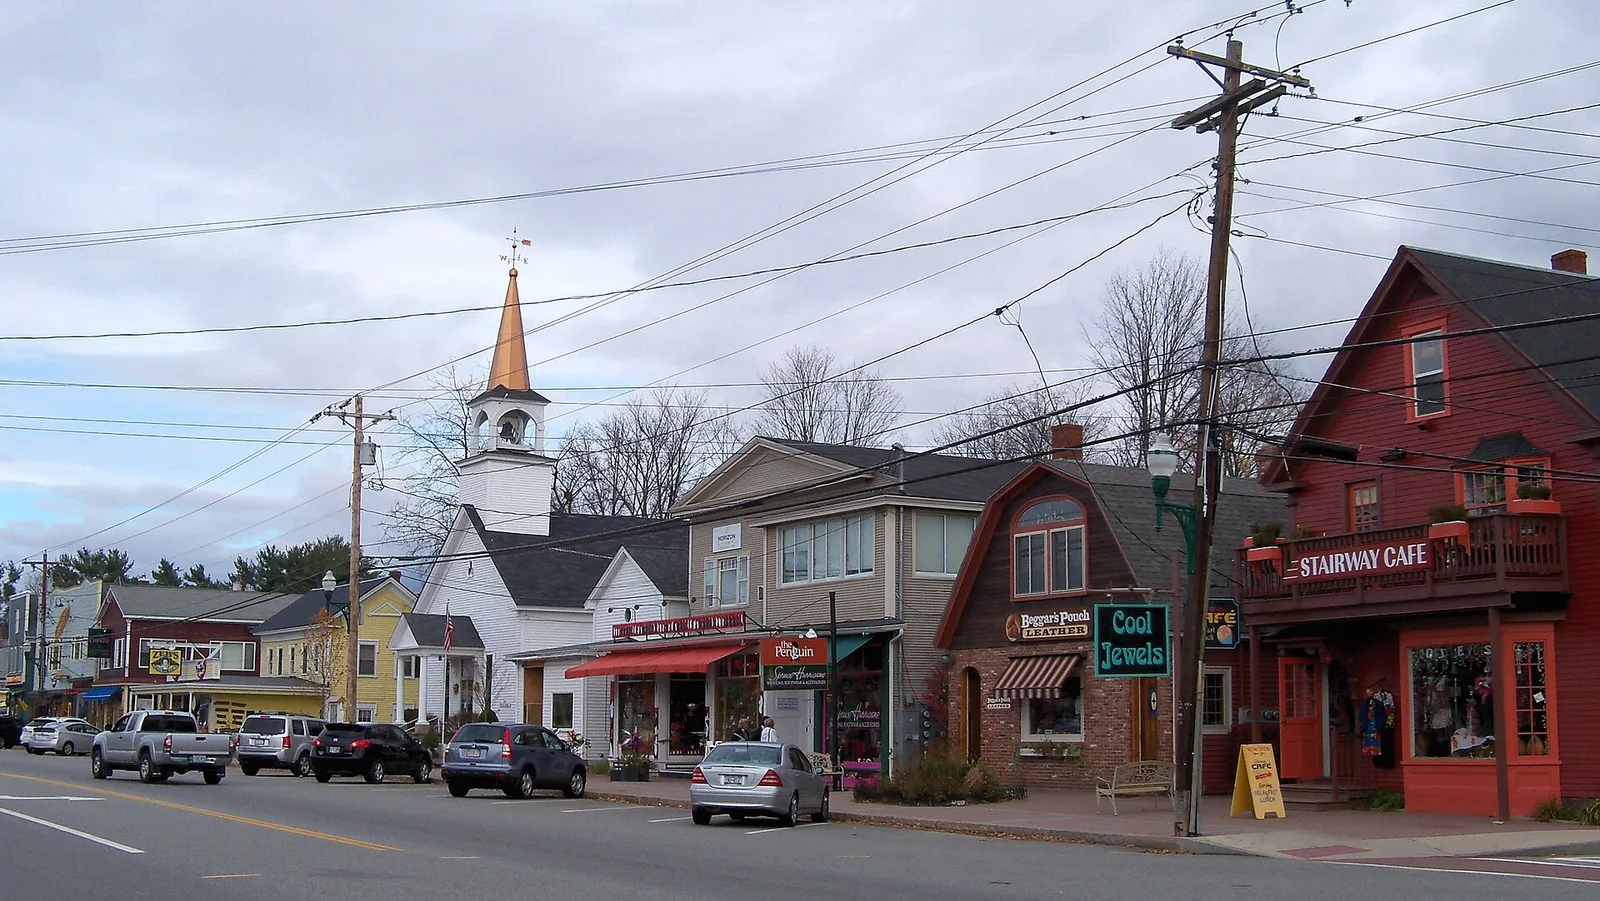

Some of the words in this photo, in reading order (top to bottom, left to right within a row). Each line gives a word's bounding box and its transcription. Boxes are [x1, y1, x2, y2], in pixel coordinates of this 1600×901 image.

[717, 533, 736, 542] HORIZON
[1300, 548, 1380, 577] STAIRWAY
[1383, 543, 1427, 568] CAFE
[1021, 612, 1059, 628] Beggar's
[1059, 609, 1090, 626] Pouch
[1112, 610, 1153, 635] Cool
[1206, 609, 1237, 624] AFÉ
[1025, 626, 1086, 637] LEATHER
[781, 640, 792, 648] the
[775, 646, 814, 660] Penguin
[1101, 642, 1164, 670] Jewels
